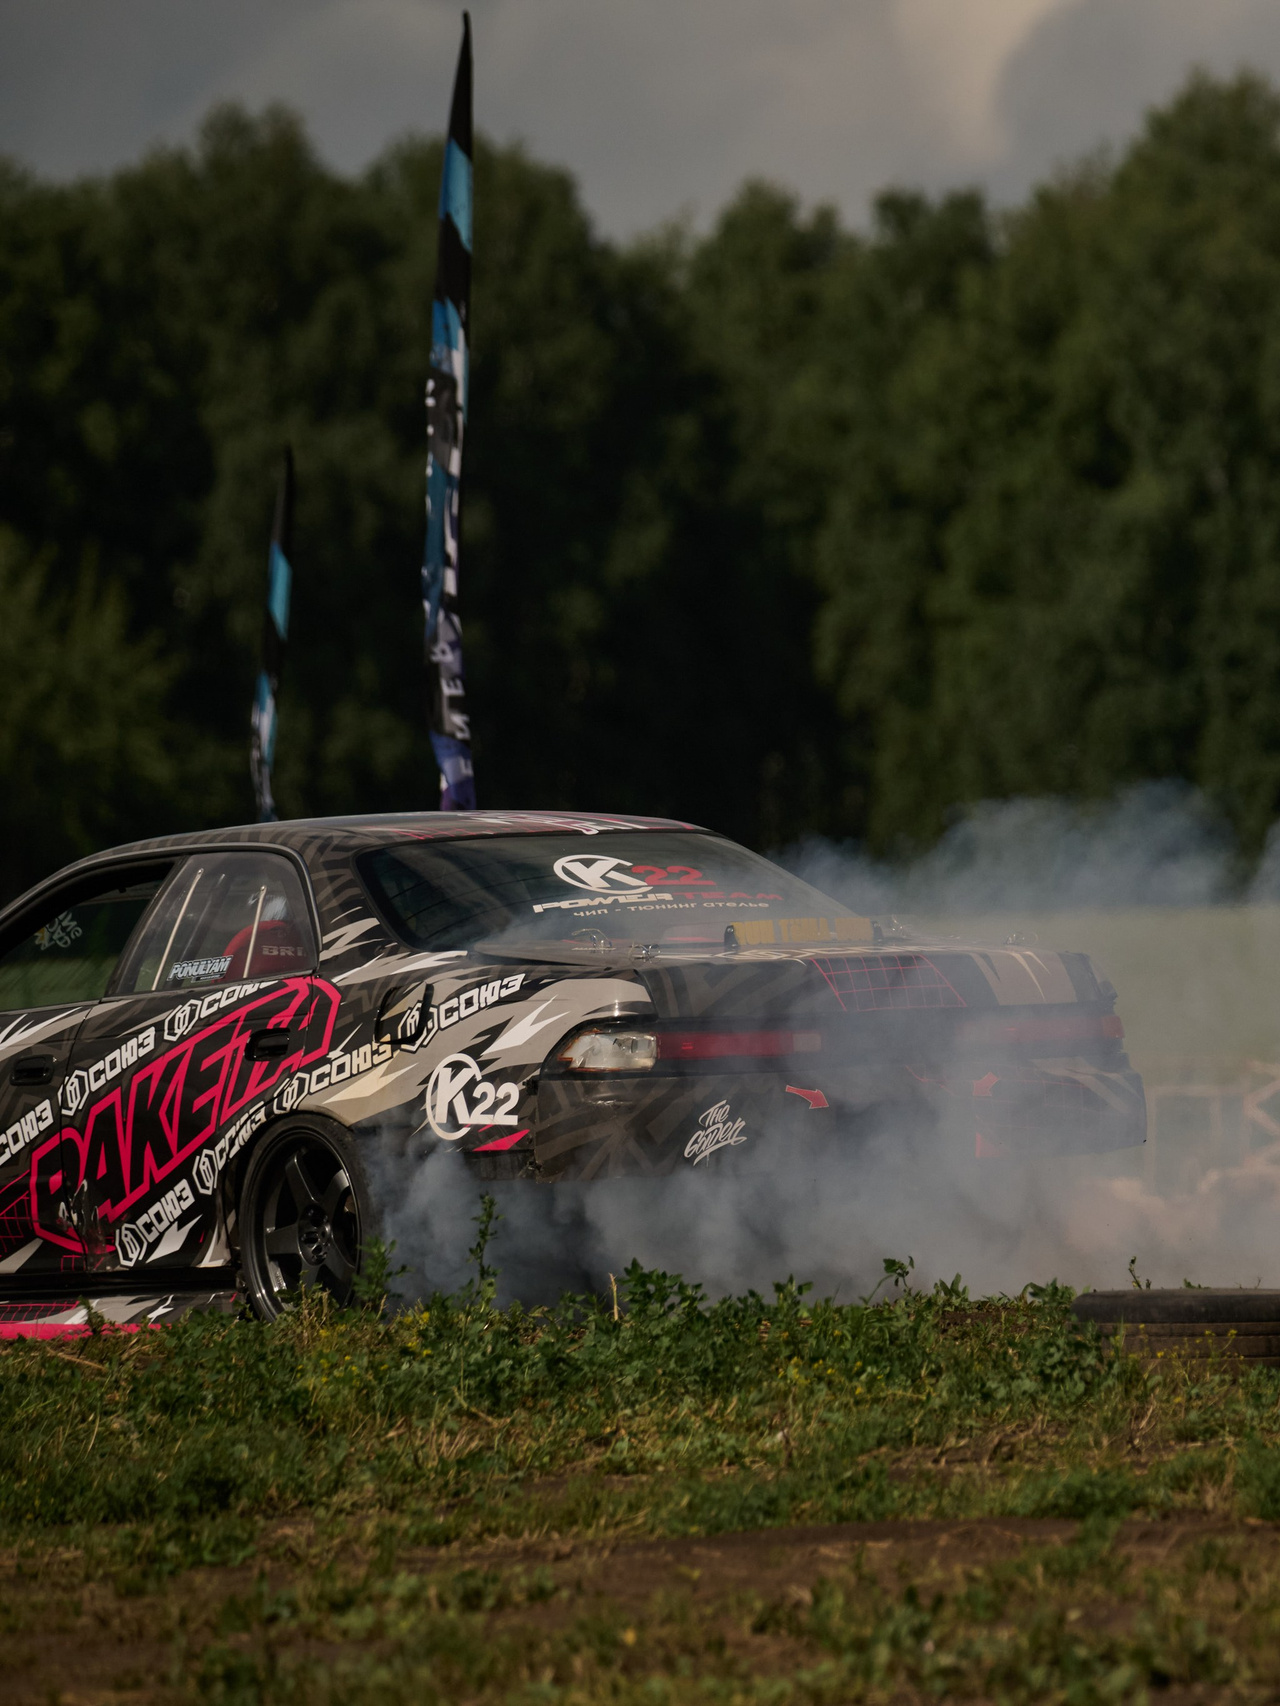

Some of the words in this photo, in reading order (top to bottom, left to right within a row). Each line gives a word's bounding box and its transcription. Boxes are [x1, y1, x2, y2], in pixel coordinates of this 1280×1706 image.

[262, 945, 307, 958] BRI
[438, 973, 526, 1028] СОЮЗ
[88, 1026, 156, 1092] СОЮЗ
[309, 1043, 392, 1095] СОЮЗ
[138, 1180, 195, 1244] СОЮЗ
